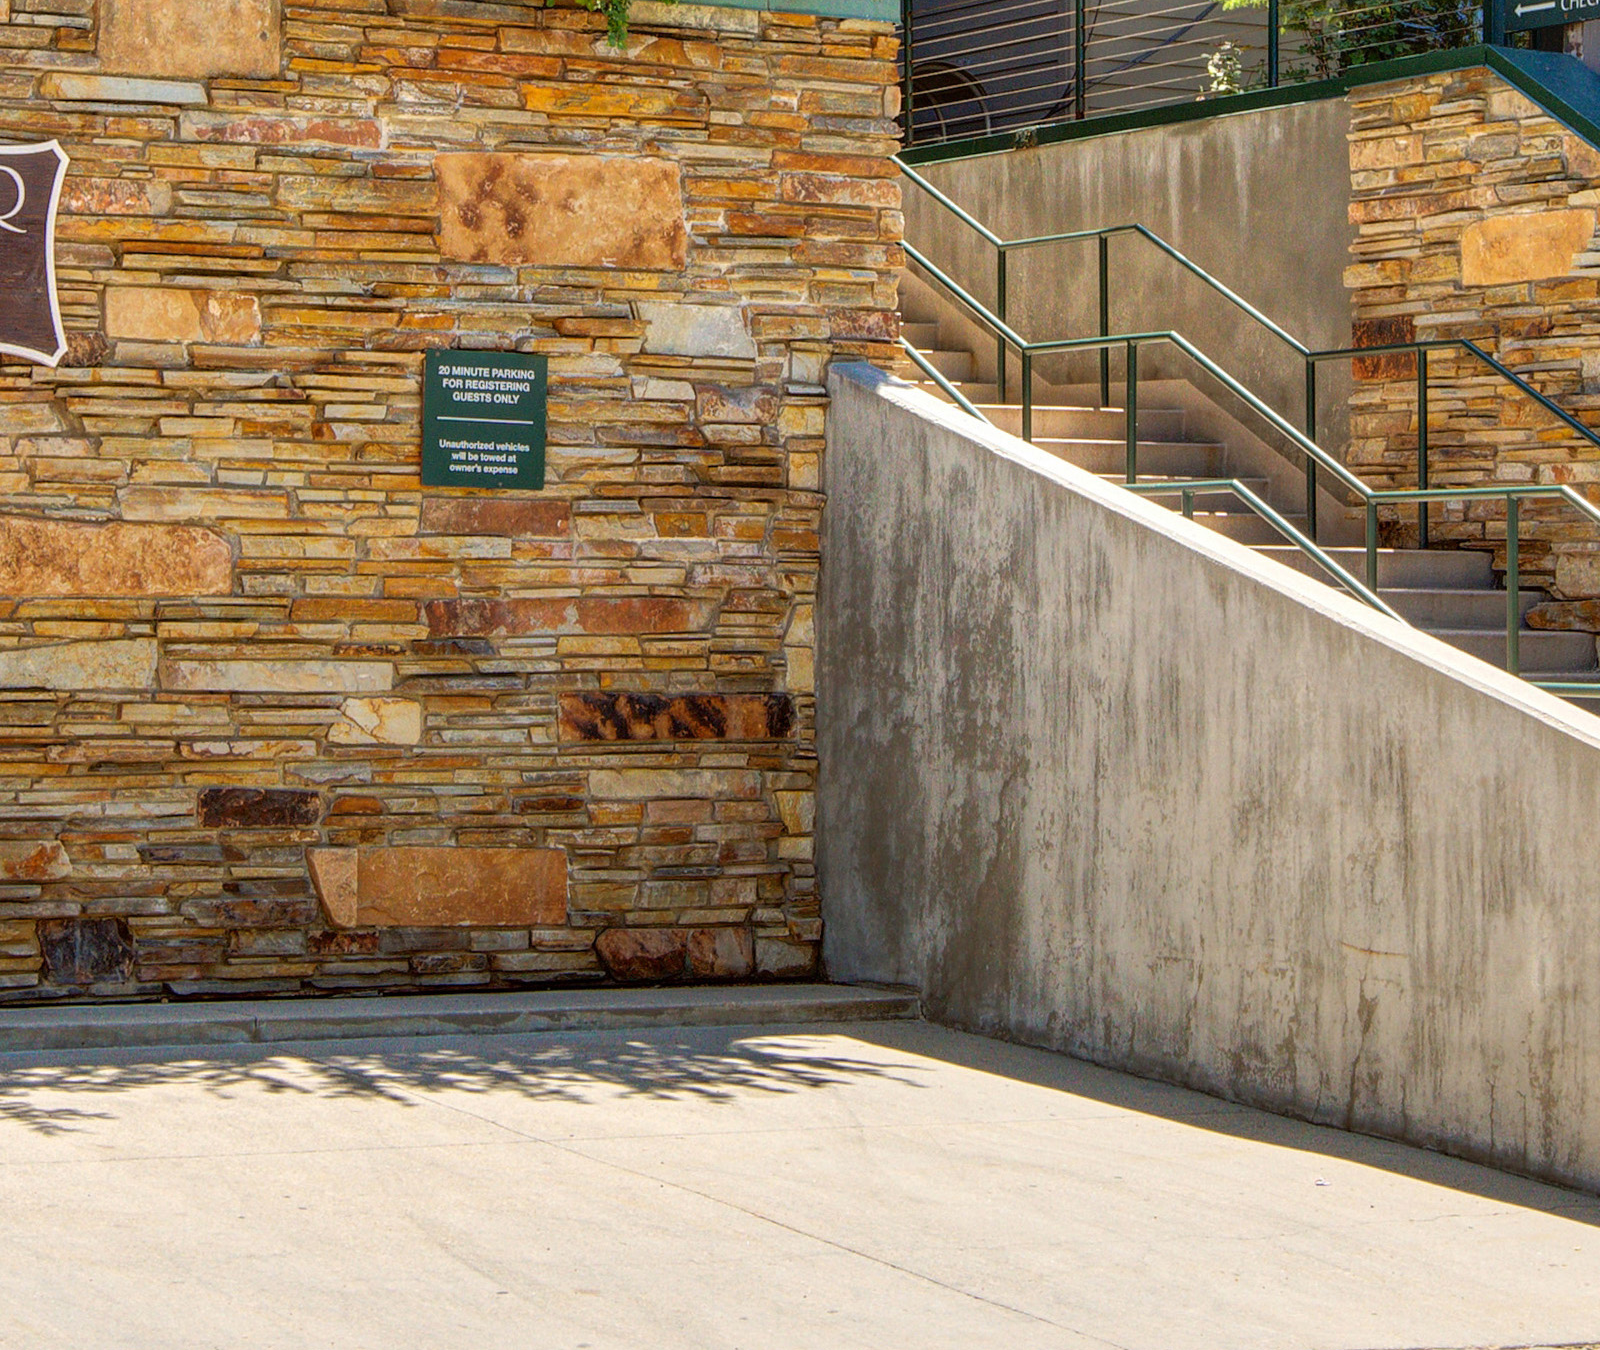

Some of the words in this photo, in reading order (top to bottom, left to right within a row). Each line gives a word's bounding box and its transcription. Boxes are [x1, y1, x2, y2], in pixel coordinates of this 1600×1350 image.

[438, 365, 450, 375] 20
[452, 366, 489, 378] MINUTE
[491, 369, 535, 380] PARKING
[442, 378, 463, 389] FOR
[465, 379, 530, 392] REGISTERING
[452, 392, 492, 403] GUESTS
[494, 393, 520, 404] ONLY
[439, 439, 494, 450] Unauthorized
[496, 442, 530, 452] vehicles
[451, 451, 466, 461] will
[468, 452, 479, 461] be
[480, 453, 506, 462] towed
[507, 454, 517, 463] at
[449, 463, 482, 472] owner's
[483, 465, 518, 475] expense
